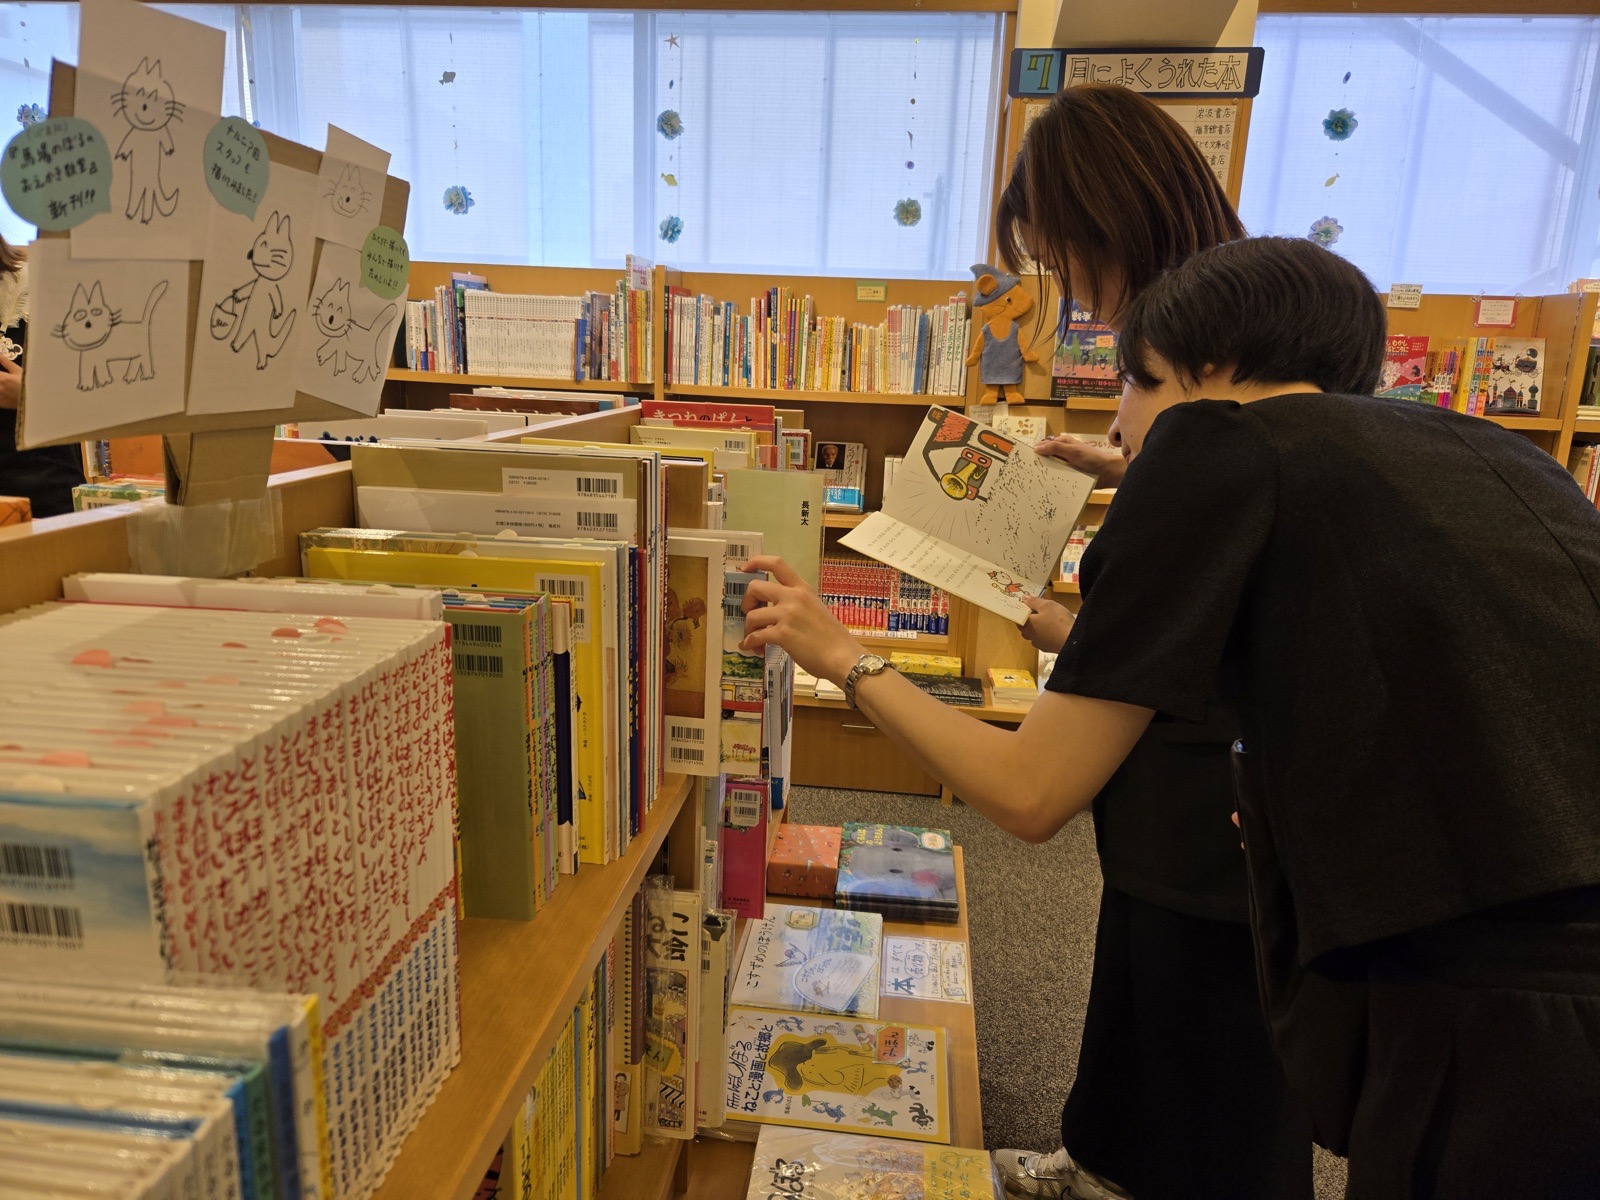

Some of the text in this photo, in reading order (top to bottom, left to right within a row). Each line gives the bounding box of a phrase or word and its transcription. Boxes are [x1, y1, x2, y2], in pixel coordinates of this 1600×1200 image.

[1197, 108, 1231, 119] 岩波書店
[800, 500, 810, 526] 長新太
[746, 915, 776, 989] こすずめのぼうけん
[740, 1024, 774, 1113] ねこと漫画と故郷と
